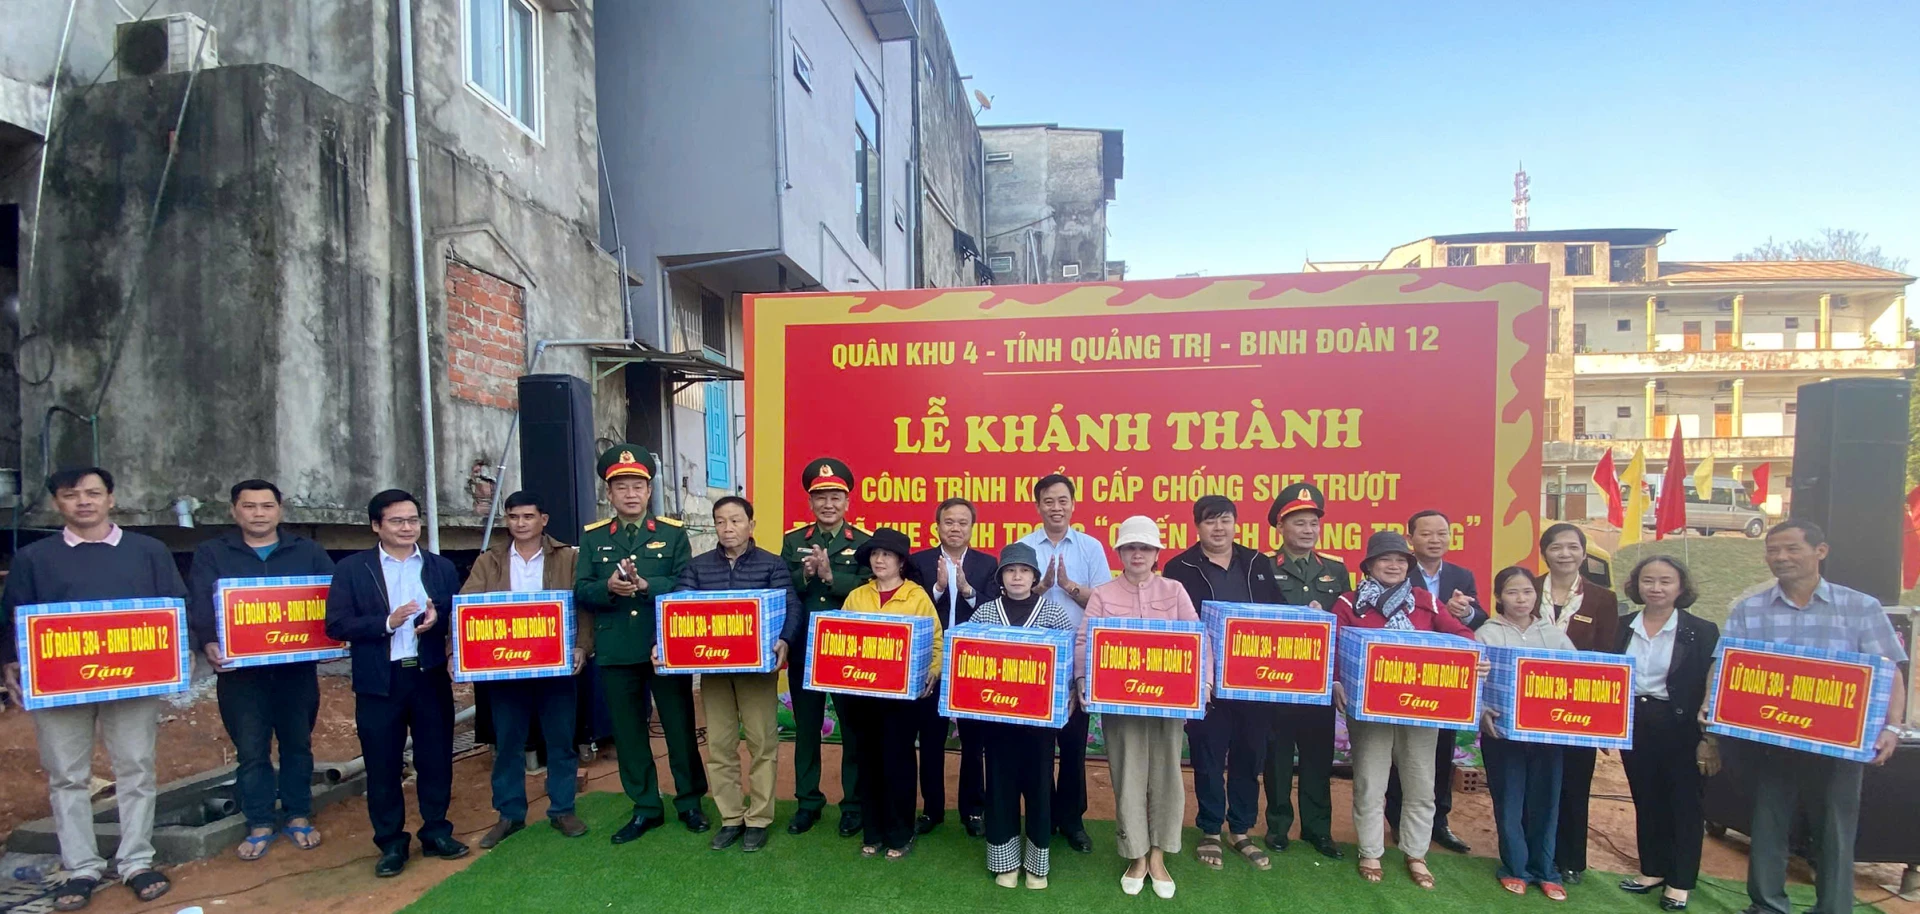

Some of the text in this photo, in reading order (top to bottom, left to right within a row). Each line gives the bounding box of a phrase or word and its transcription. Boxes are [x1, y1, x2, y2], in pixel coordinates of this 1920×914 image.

[832, 339, 898, 369] QUÂN
[907, 342, 955, 366] KHU
[963, 341, 978, 364] 4
[1004, 331, 1062, 363] TỈNH
[1071, 328, 1160, 364] QUẢNG
[1170, 333, 1211, 362] TRỊ
[1240, 330, 1307, 356] BINH
[1316, 322, 1394, 354] ĐOÀN
[1405, 326, 1440, 351] 12
[894, 397, 1363, 454] LỄ KHÁNH THÀNH
[862, 472, 926, 502] CÔNG
[936, 472, 1004, 502] TRÌNH
[1092, 467, 1144, 502] CẤP
[1153, 466, 1244, 502] CHỐNG
[1313, 471, 1400, 506] TRƯỢT
[245, 598, 266, 624] ĐOÀN
[268, 602, 281, 623] 384
[288, 600, 305, 622] BINH
[307, 596, 326, 620] ĐOÀN
[679, 612, 695, 637] ĐOÀN
[696, 616, 707, 637] 384
[712, 615, 726, 637] BINH
[728, 610, 744, 636] ĐOÀN
[745, 615, 753, 636] 12
[55, 626, 81, 657] ĐOÀN
[83, 631, 100, 656] 384
[107, 628, 130, 653] BINH
[132, 622, 156, 651] ĐOÀN
[158, 626, 169, 649] 12
[266, 631, 309, 645] Tặng
[476, 615, 493, 640] ĐOÀN
[495, 618, 507, 640] 384
[512, 618, 528, 639] BINH
[529, 613, 546, 638] ĐOÀN
[548, 617, 556, 637] 12
[492, 648, 531, 661] Tặng
[694, 645, 730, 659] Tặng
[830, 630, 846, 657] ĐOÀN
[847, 636, 857, 658] 384
[862, 636, 876, 659] BINH
[877, 634, 894, 660] ĐOÀN
[895, 639, 903, 661] 12
[1110, 641, 1127, 670] ĐOÀN
[1128, 647, 1140, 671] 384
[1146, 648, 1162, 672] BINH
[1164, 644, 1182, 673] ĐOÀN
[1184, 650, 1192, 674] 12
[1242, 631, 1259, 658] ĐOÀN
[1260, 636, 1272, 658] 384
[1277, 636, 1293, 659] BINH
[1294, 633, 1312, 661] ĐOÀN
[1313, 639, 1321, 660] 12
[80, 664, 134, 680] Tặng
[842, 665, 877, 682] Tặng
[968, 650, 983, 680] ĐOÀN
[985, 657, 996, 680] 384
[1002, 658, 1017, 683] BINH
[1019, 655, 1037, 684] ĐOÀN
[1038, 662, 1046, 685] 12
[1256, 666, 1294, 683] Tặng
[1385, 656, 1403, 684] ĐOÀN
[1404, 662, 1416, 685] 384
[1422, 663, 1439, 686] BINH
[1440, 661, 1459, 688] ĐOÀN
[1460, 666, 1469, 689] 12
[980, 688, 1018, 707] Tặng
[1124, 679, 1163, 697] Tặng
[1536, 671, 1554, 699] ĐOÀN
[1555, 677, 1567, 700] 384
[1573, 678, 1590, 701] BINH
[1592, 675, 1611, 703] ĐOÀN
[1612, 681, 1621, 704] 12
[1742, 664, 1768, 694] ĐOÀN
[1767, 672, 1784, 697] 384
[1791, 675, 1816, 702] BINH
[1815, 675, 1843, 706] ĐOÀN
[1843, 684, 1856, 708] 12
[1399, 693, 1439, 711] Tặng
[1550, 709, 1591, 726] Tặng
[1760, 705, 1812, 729] Tặng
